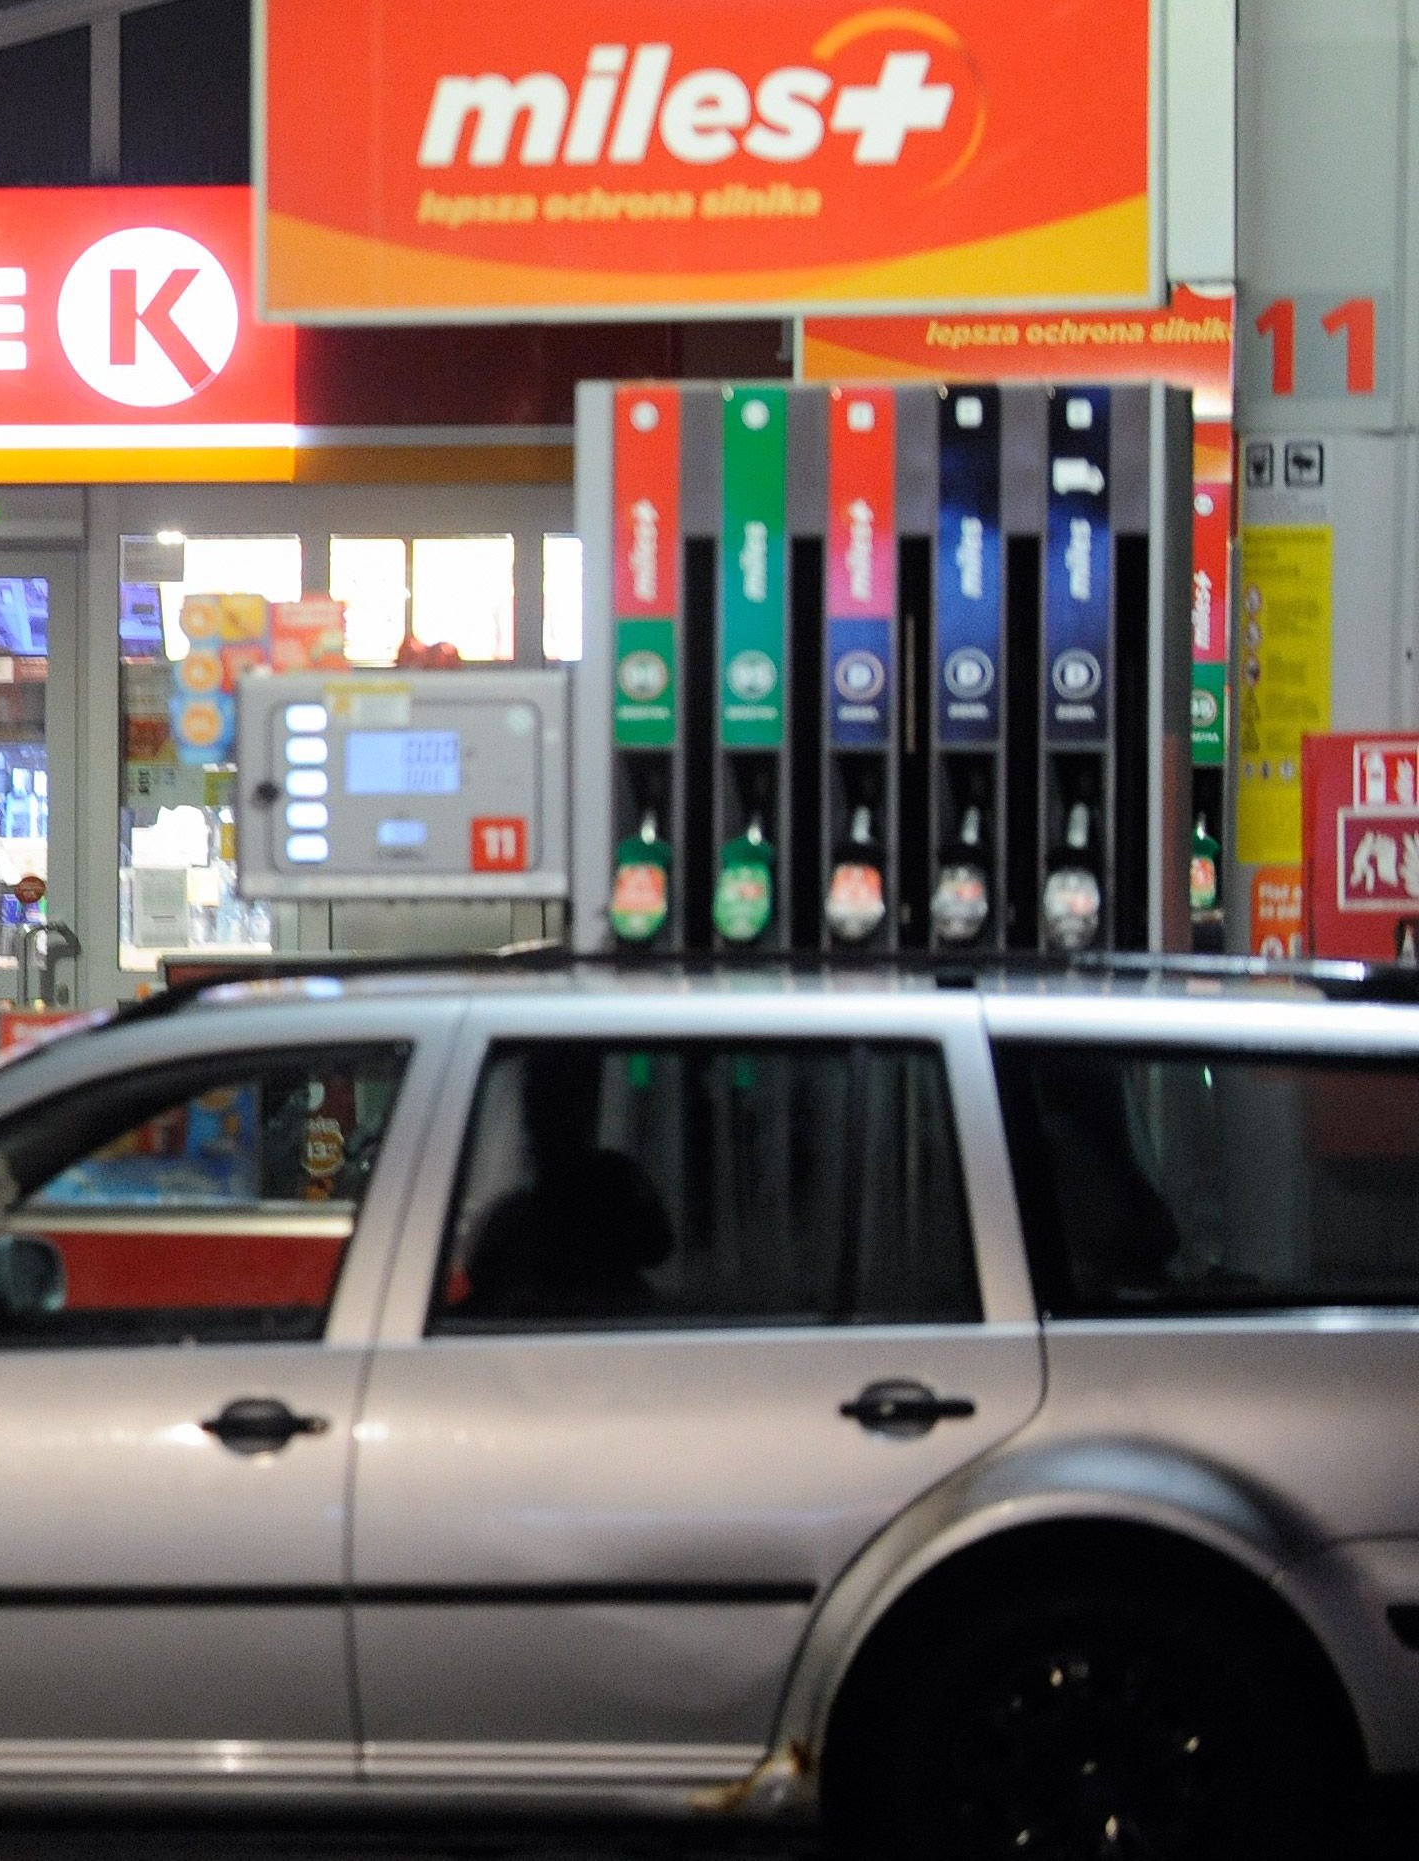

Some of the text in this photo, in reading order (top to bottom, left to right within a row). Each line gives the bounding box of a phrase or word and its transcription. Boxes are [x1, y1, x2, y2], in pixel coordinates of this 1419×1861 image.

[419, 44, 953, 166] miles+
[418, 184, 821, 226] lepsza ochrona silnika
[108, 268, 218, 395] K
[926, 318, 1021, 349] lepsza
[1024, 317, 1145, 346] ochrona
[1255, 296, 1375, 396] 11
[482, 826, 516, 861] 11
